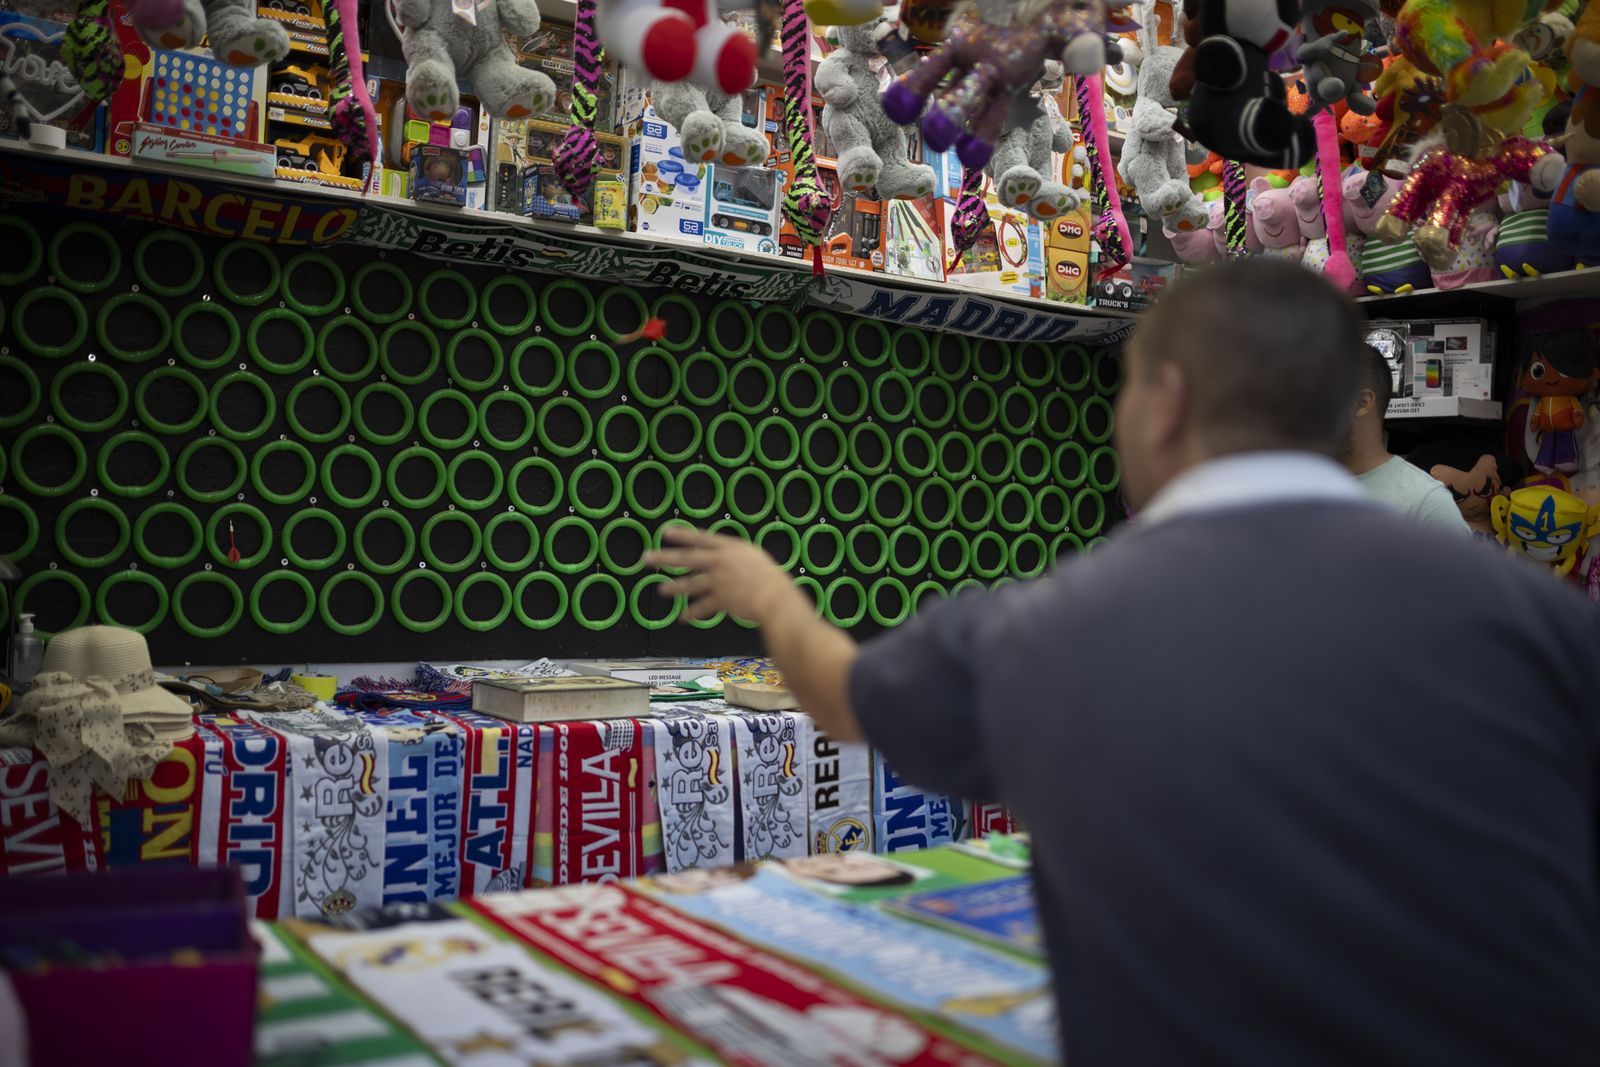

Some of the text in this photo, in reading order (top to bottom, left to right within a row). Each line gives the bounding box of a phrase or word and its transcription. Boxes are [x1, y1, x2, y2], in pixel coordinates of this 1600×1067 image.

[410, 229, 534, 267] Betis
[705, 233, 723, 244] DIY
[645, 261, 751, 298] Betis
[857, 289, 1079, 342] MADRID
[1098, 298, 1129, 308] TRUCK'S
[205, 747, 226, 775] TÚ
[434, 791, 457, 898] MEJOR
[559, 785, 569, 887] DESDE
